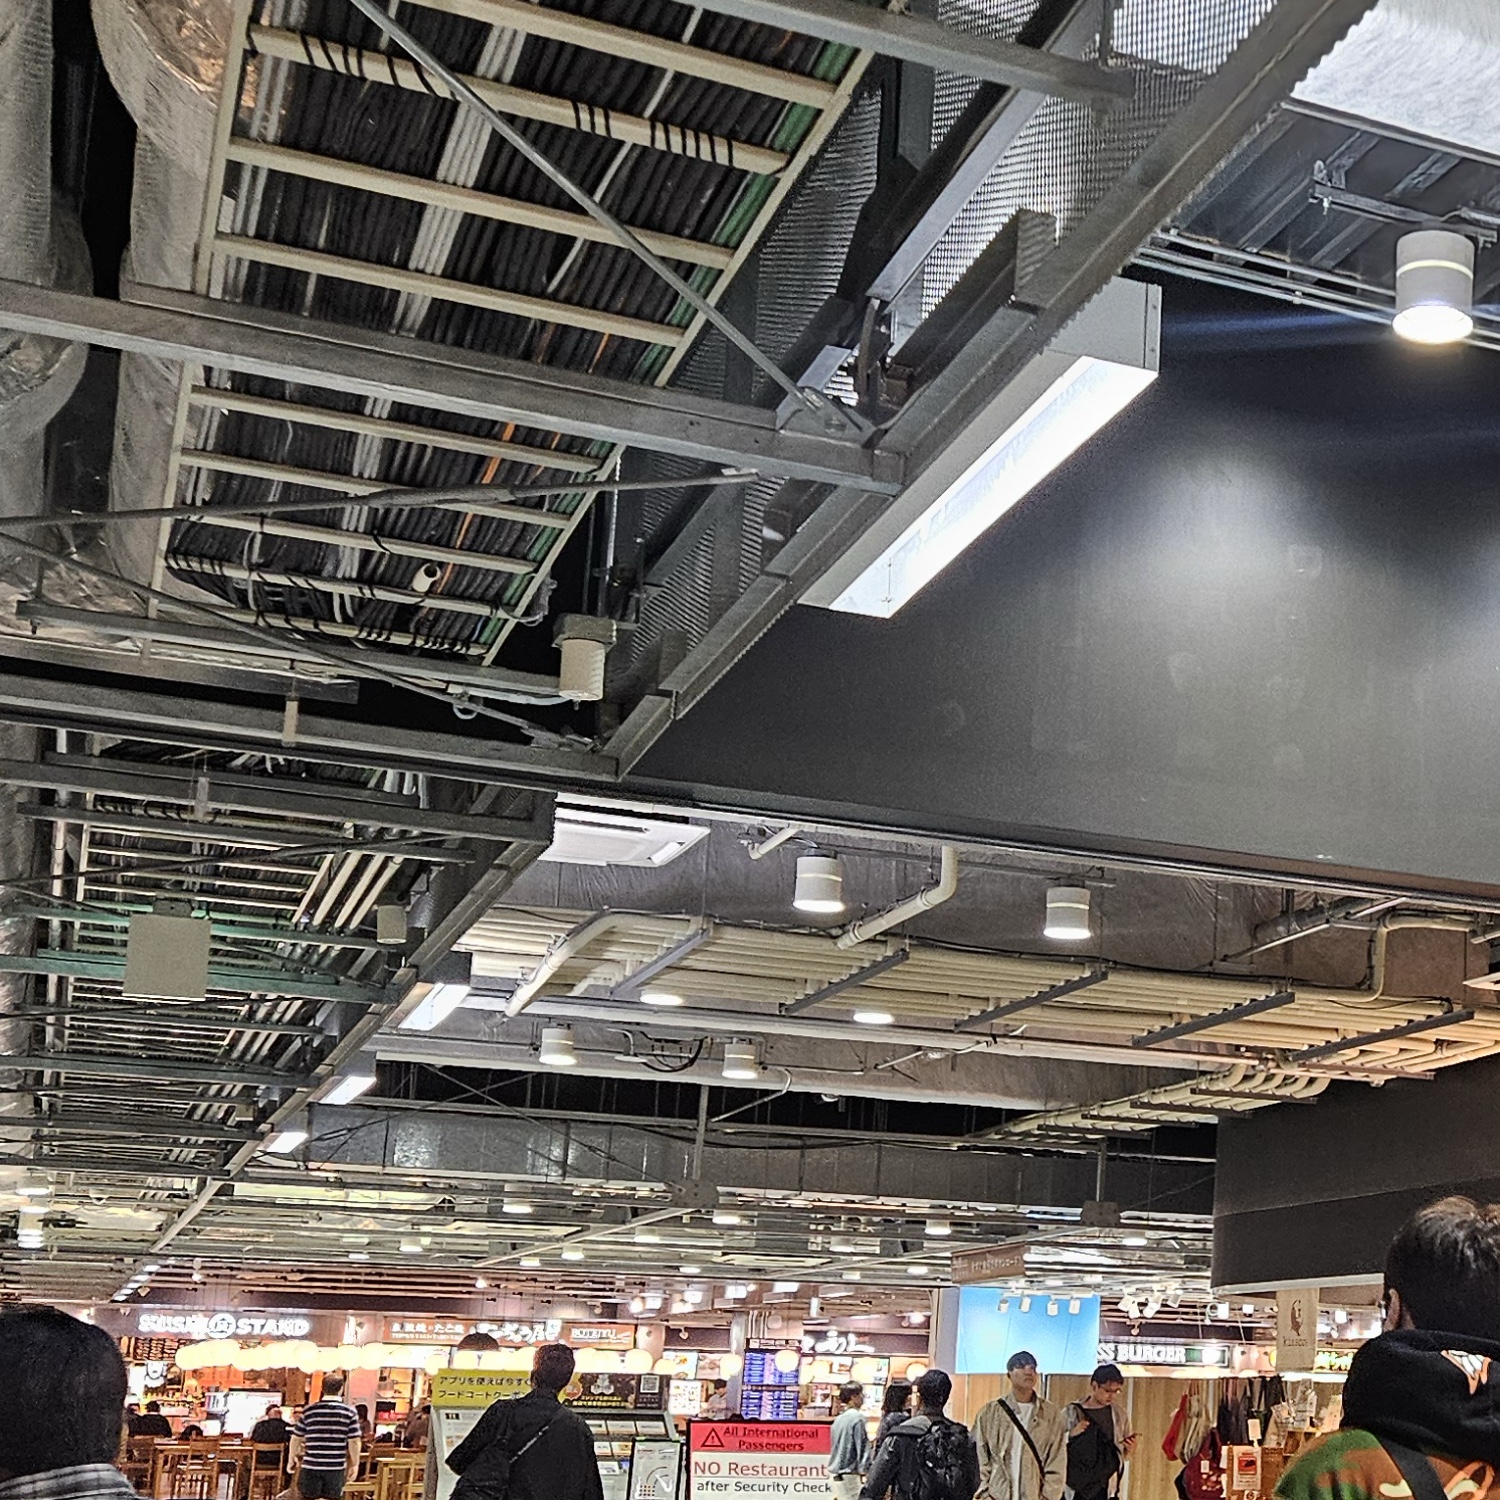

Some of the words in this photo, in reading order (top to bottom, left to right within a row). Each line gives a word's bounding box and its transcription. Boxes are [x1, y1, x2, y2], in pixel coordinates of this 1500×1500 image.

[1117, 1344, 1186, 1363] BURGER
[723, 1426, 738, 1437] All
[742, 1427, 819, 1439] International
[738, 1440, 805, 1452] Passengers
[694, 1461, 721, 1476] NO
[696, 1480, 730, 1492] after
[734, 1481, 789, 1494] Security
[793, 1482, 832, 1493] Check
